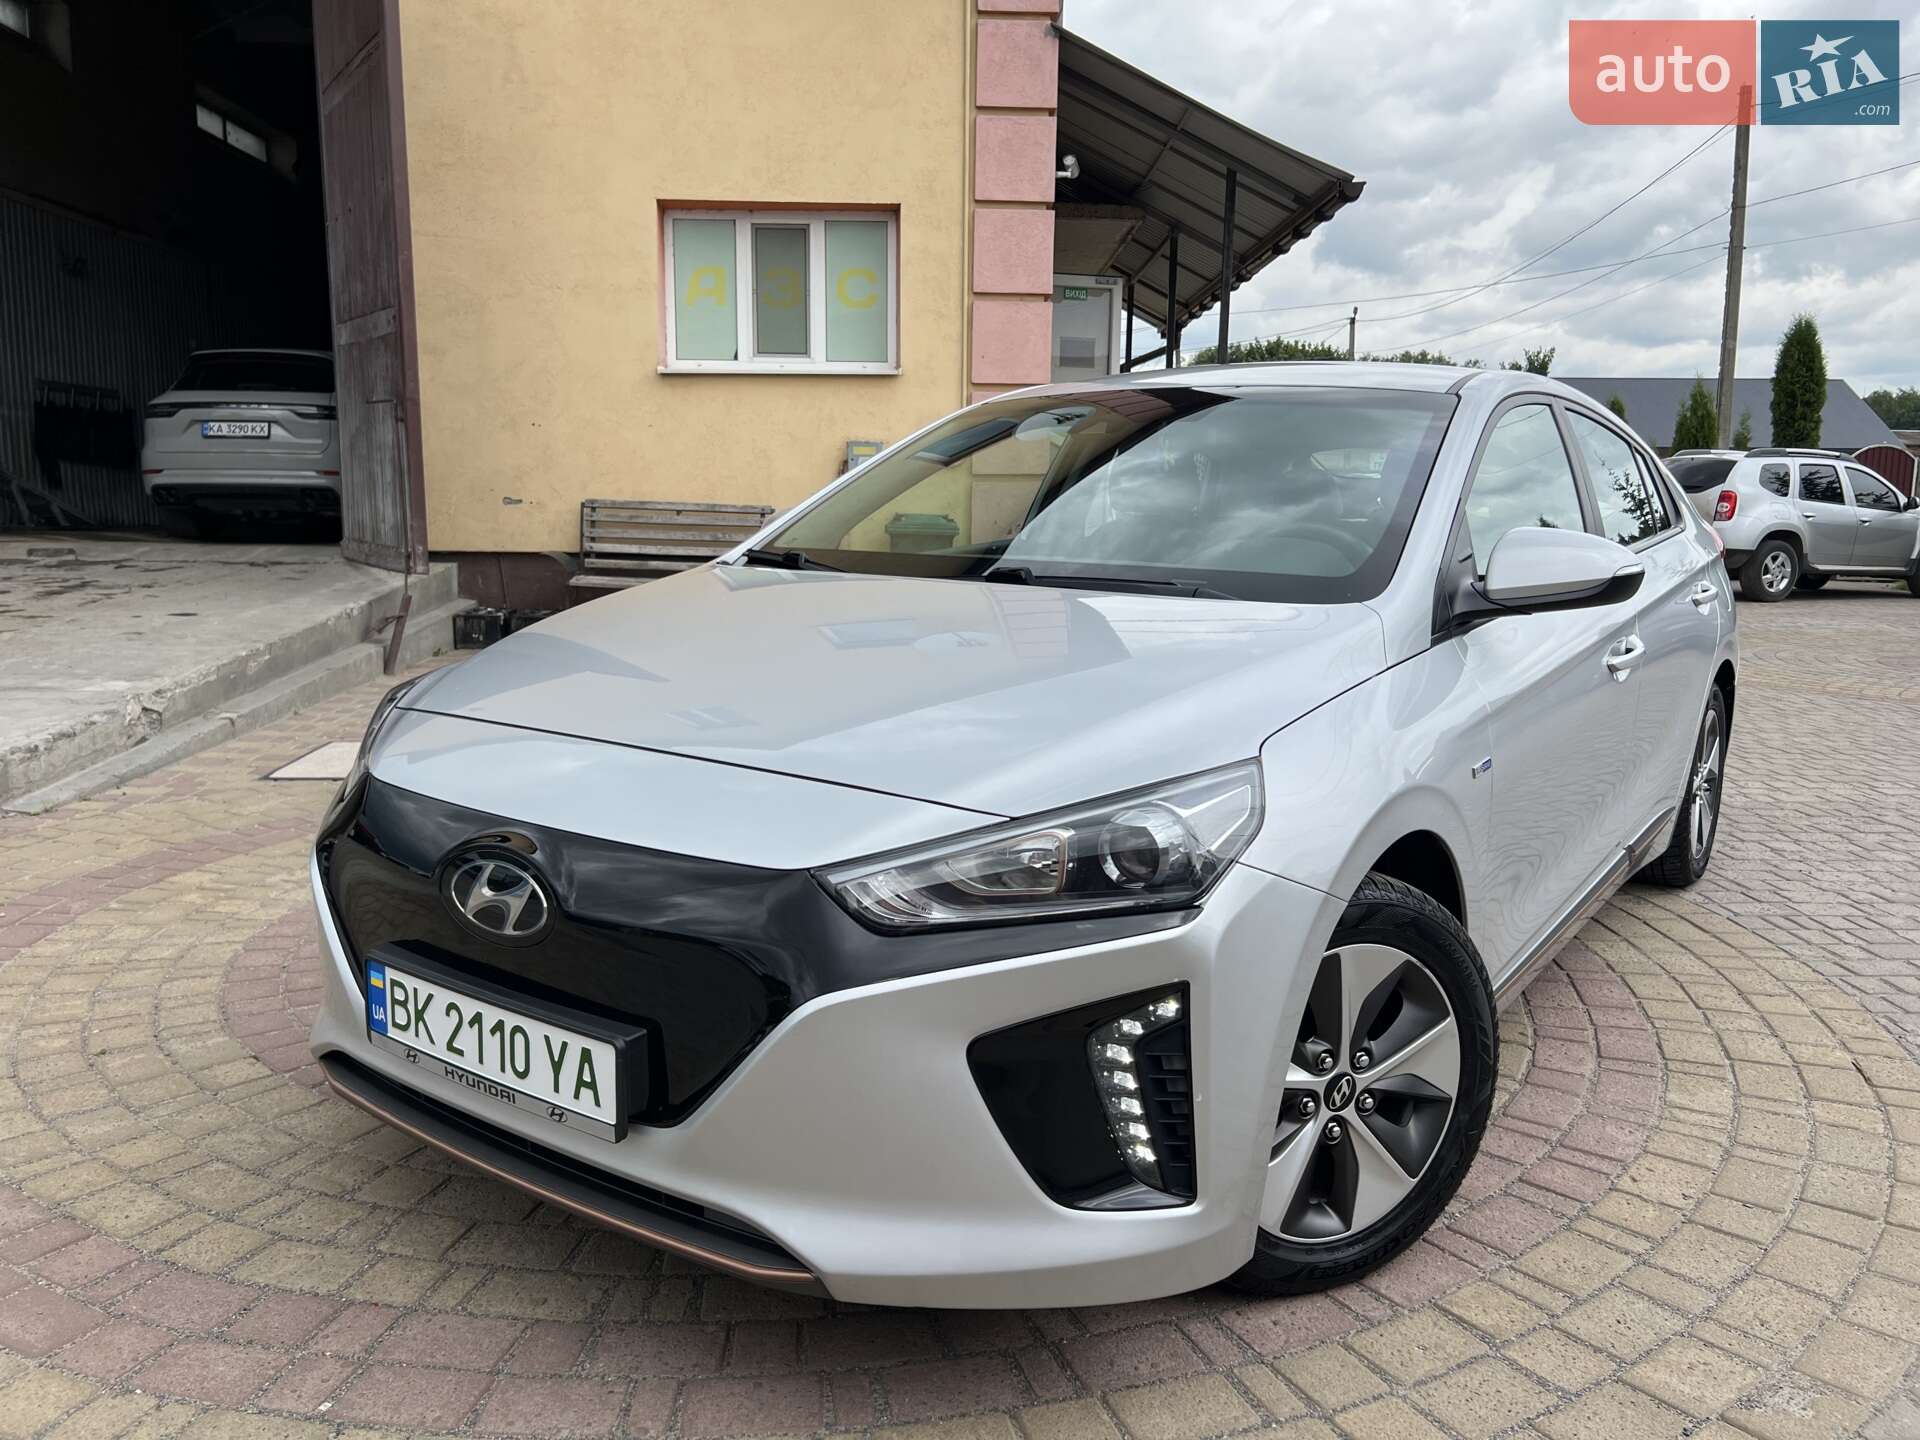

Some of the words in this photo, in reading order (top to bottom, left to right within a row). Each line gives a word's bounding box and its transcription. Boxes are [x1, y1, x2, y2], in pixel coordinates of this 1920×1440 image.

[209, 423, 224, 433] KA
[226, 423, 249, 434] 3290
[251, 424, 266, 434] KX
[372, 1003, 386, 1023] UA
[389, 976, 436, 1046] BK
[445, 1001, 531, 1080] 2110
[543, 1033, 601, 1108] YA
[444, 1065, 517, 1105] HYUNDAI
